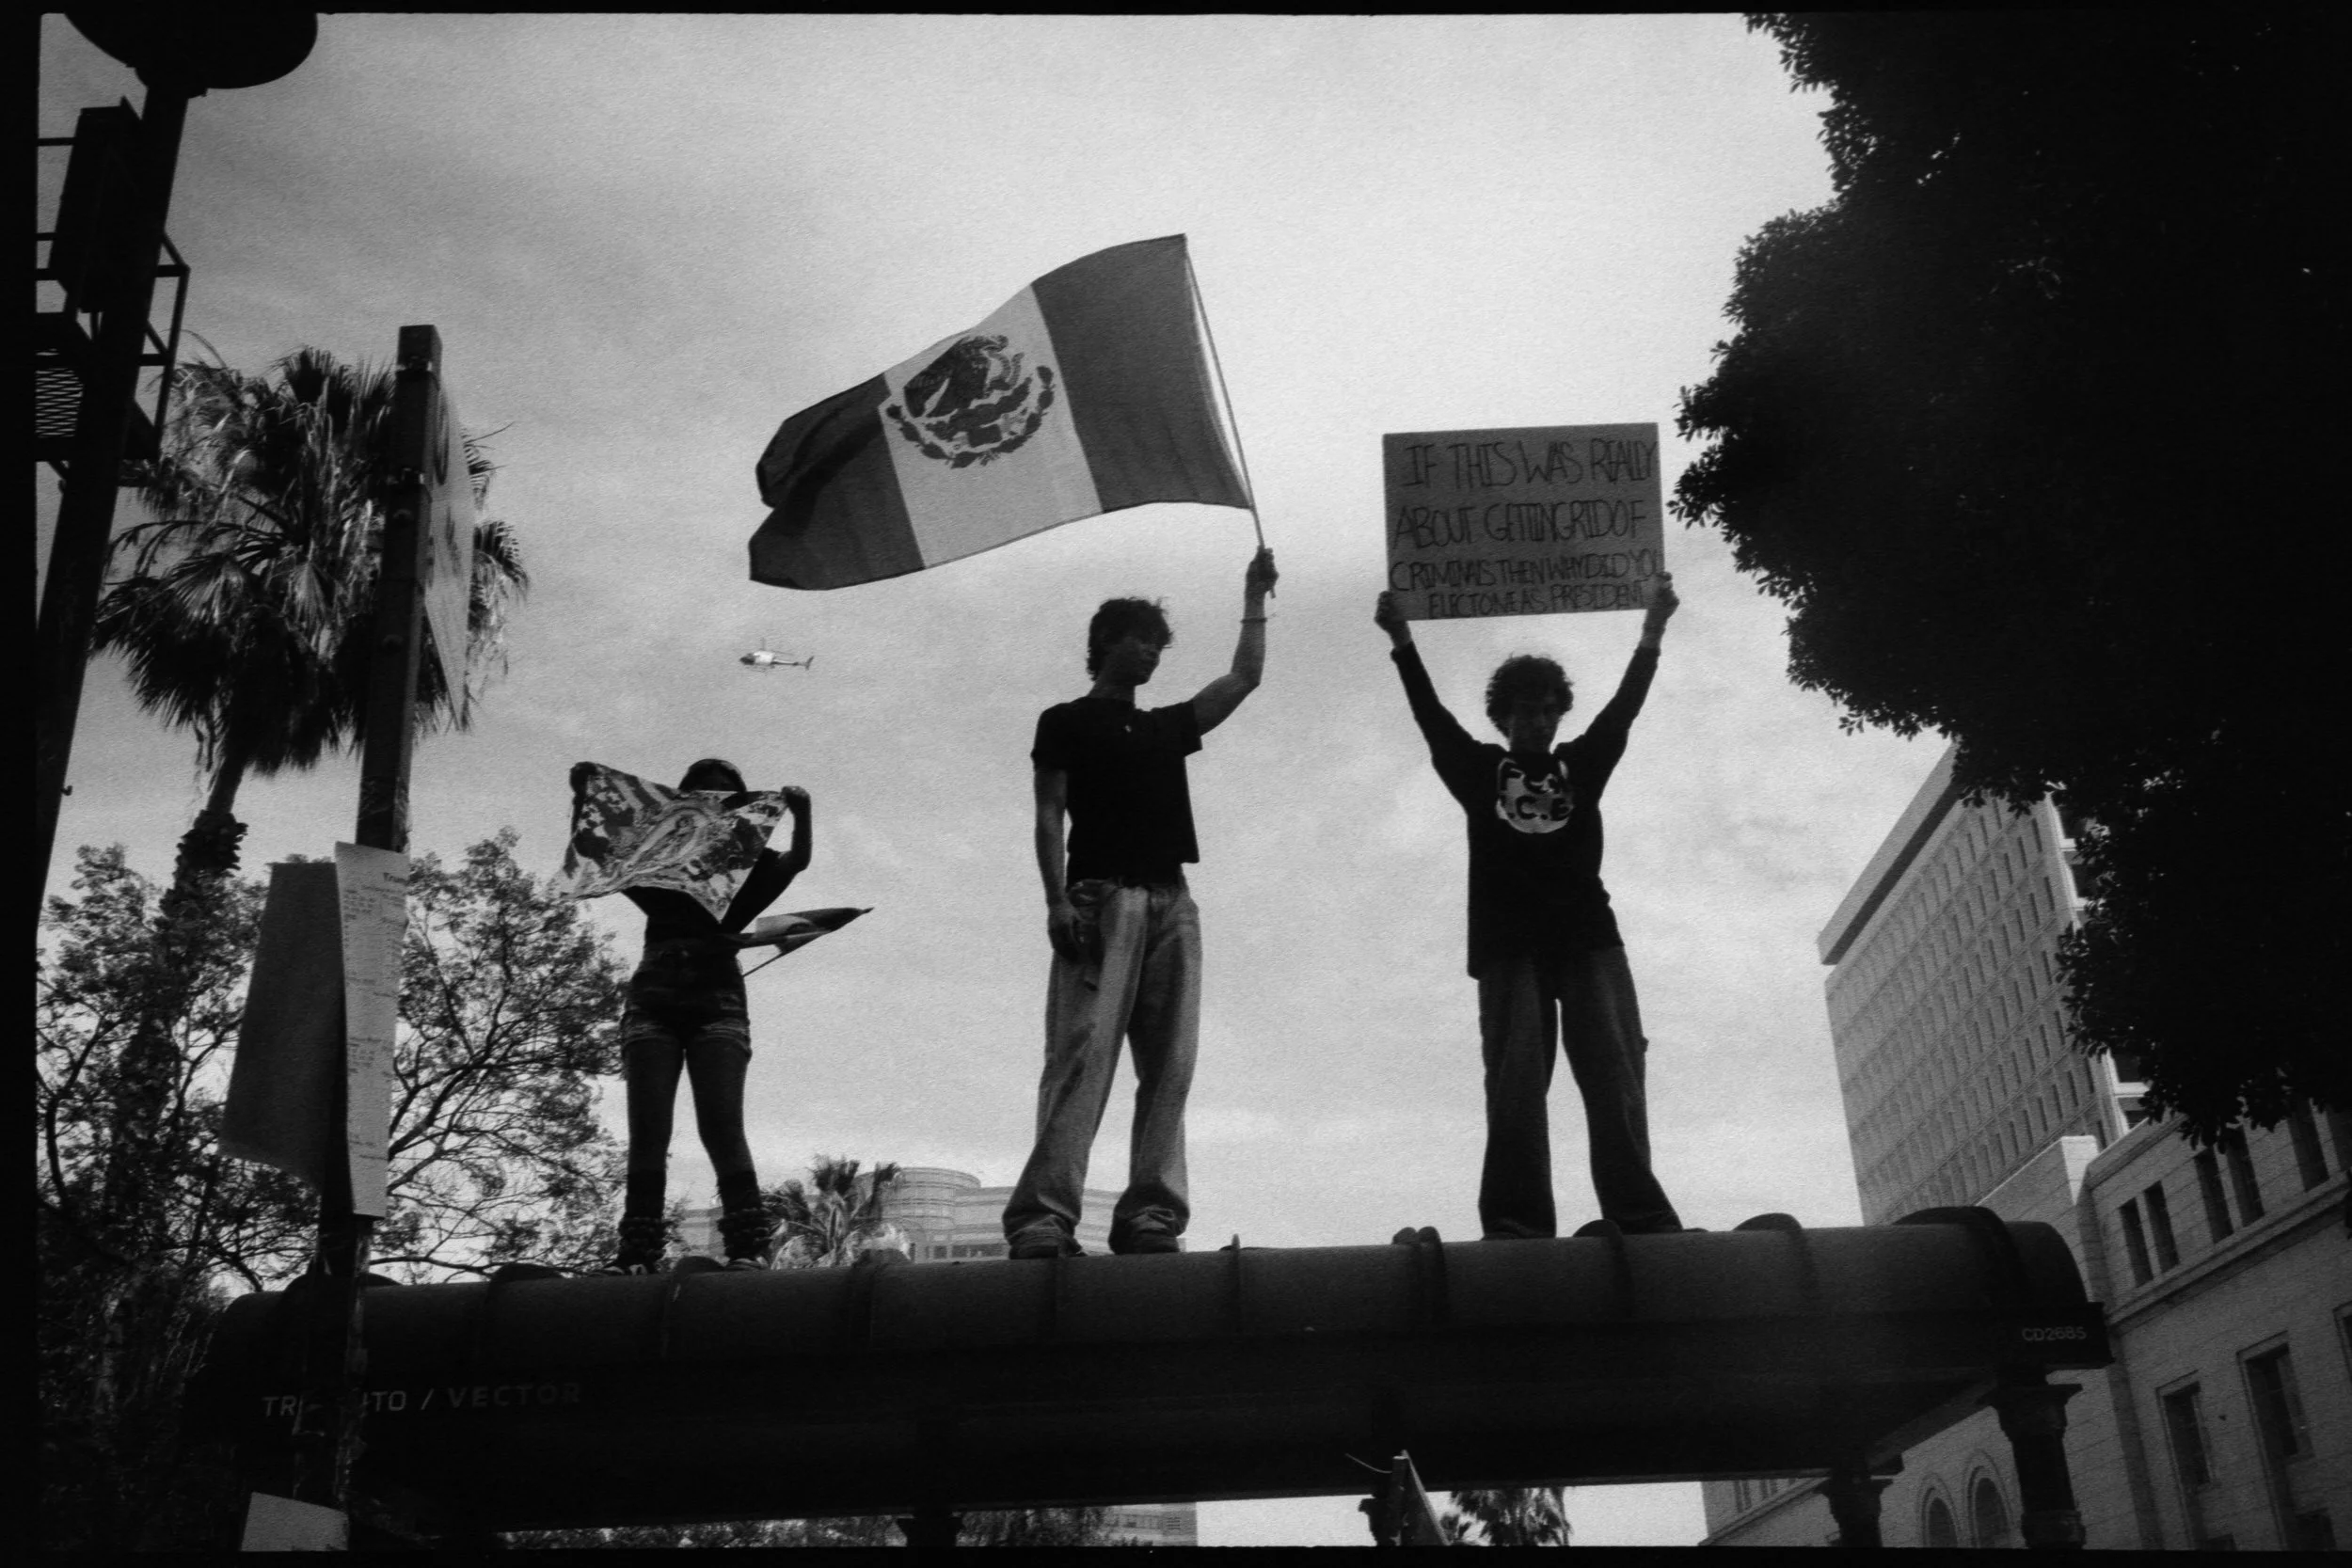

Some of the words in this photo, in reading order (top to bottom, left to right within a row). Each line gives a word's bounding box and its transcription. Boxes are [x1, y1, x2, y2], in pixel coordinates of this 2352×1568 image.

[1402, 444, 1438, 488] IF
[1446, 442, 1518, 488] THIS
[1518, 440, 1584, 485] WAS
[1590, 438, 1657, 484] REALLY
[1392, 505, 1476, 549] ABOUT
[1570, 499, 1613, 539] RID
[1612, 499, 1646, 539] OF
[1390, 560, 1497, 591] CRIMINALS
[1496, 559, 1545, 585] THEN
[1546, 555, 1585, 580] WHY
[1584, 553, 1630, 580] DID
[1519, 587, 1548, 614] AS
[447, 1382, 581, 1409] VECTOR
